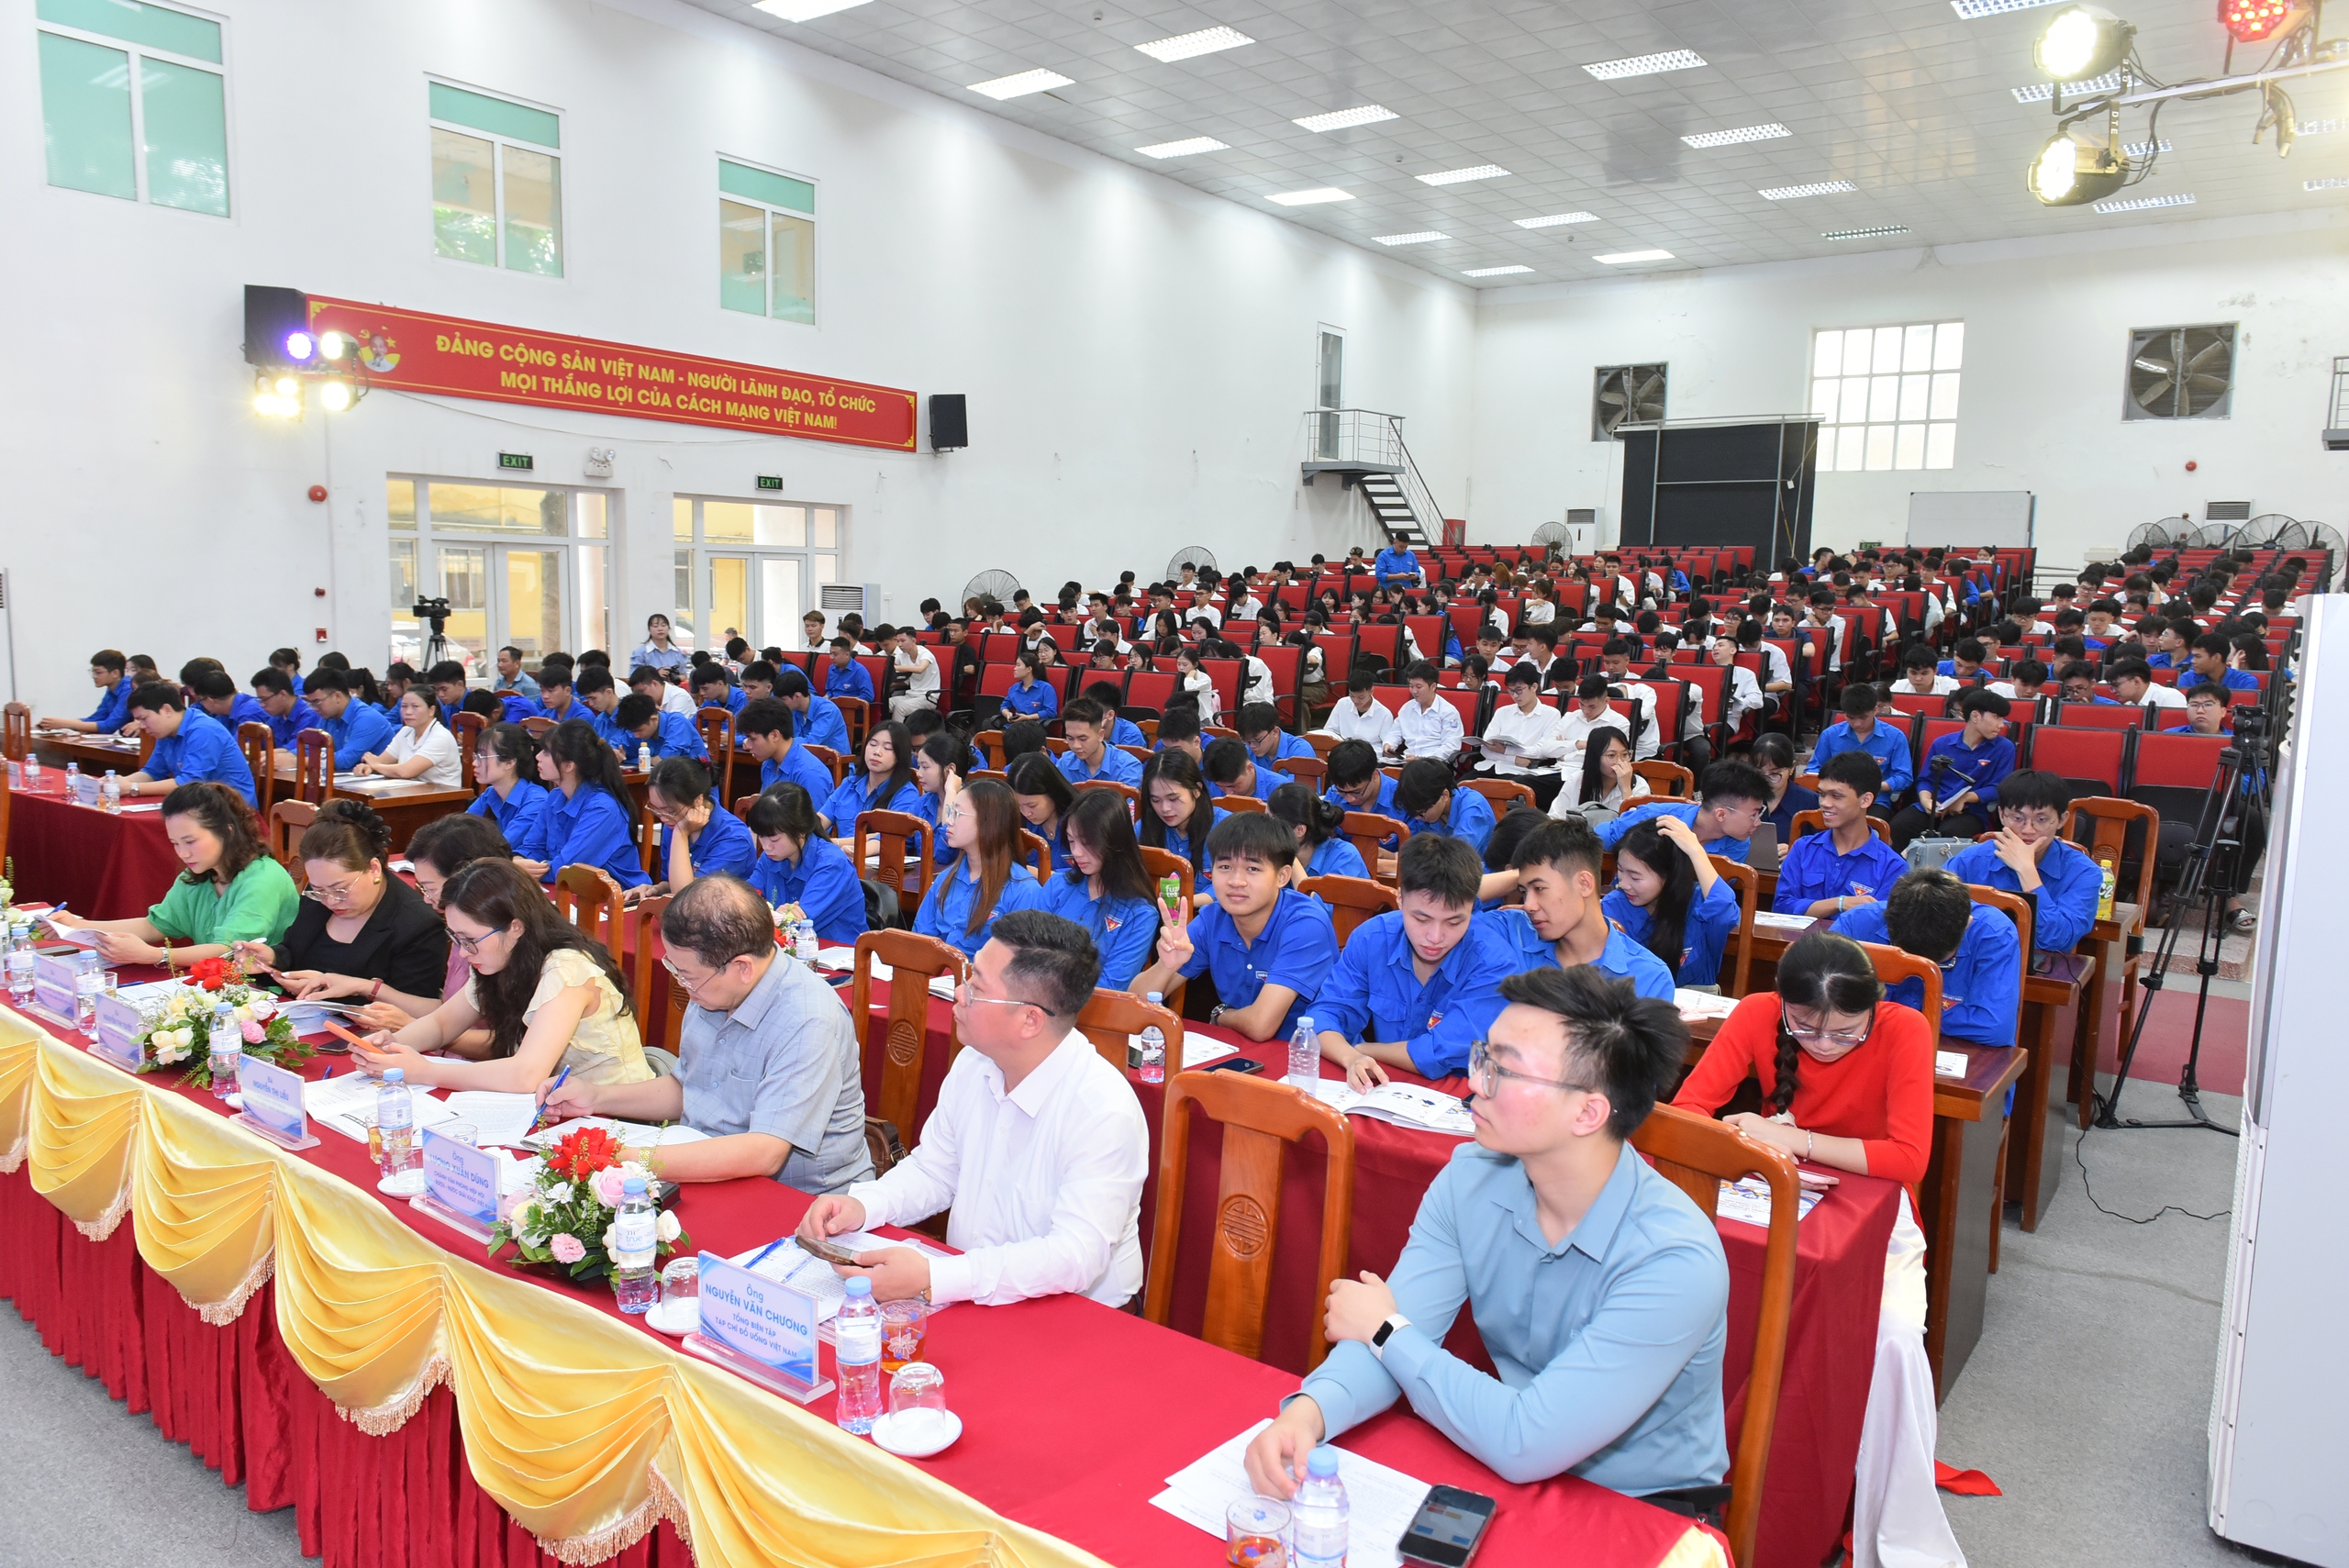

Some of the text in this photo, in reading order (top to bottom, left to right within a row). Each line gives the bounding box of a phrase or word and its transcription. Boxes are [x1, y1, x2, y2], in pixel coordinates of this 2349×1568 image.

[436, 331, 495, 359] ĐẢNG
[499, 342, 557, 367] CỘNG
[562, 350, 596, 373] SẢN
[601, 357, 634, 382] VIỆT
[639, 364, 674, 384] NAM
[687, 372, 737, 393] NGƯỜI
[741, 377, 777, 399] LÃNH
[781, 386, 815, 406] ĐẠO,
[818, 386, 836, 407] TỔ
[839, 395, 876, 413] CHỨC
[501, 371, 837, 429] MỌI THẮNG LỢI CỦA CÁCH MẠNG VIỆT NAM!
[503, 455, 529, 468] EXIT
[760, 477, 780, 488] EXIT
[2099, 883, 2113, 899] C2
[452, 1151, 463, 1165] Ông
[471, 1173, 489, 1188] DŨNG
[747, 1284, 763, 1303] Ông
[706, 1284, 807, 1336] NGUYỄN VĂN CHƯƠNG
[733, 1312, 776, 1338] TỔNG BIÊN TẬP
[716, 1317, 726, 1327] TẠP
[728, 1322, 738, 1332] CHÍ
[750, 1332, 768, 1345] UỐNG
[769, 1340, 781, 1352] VIỆT
[783, 1347, 797, 1358] NAM
